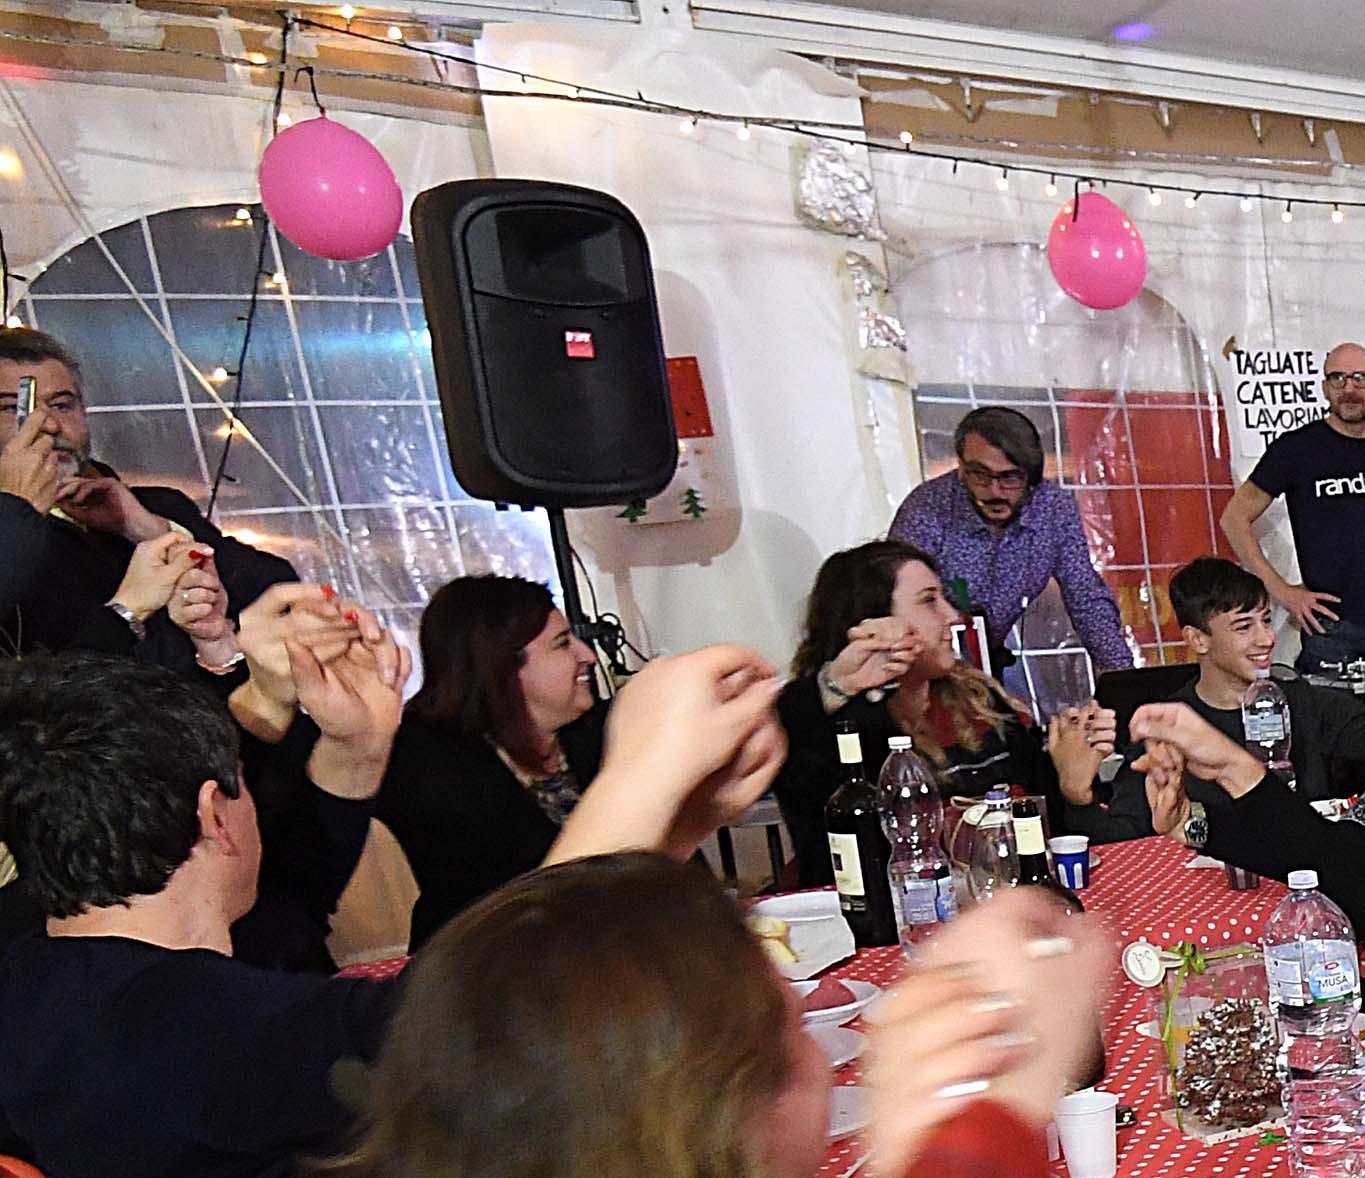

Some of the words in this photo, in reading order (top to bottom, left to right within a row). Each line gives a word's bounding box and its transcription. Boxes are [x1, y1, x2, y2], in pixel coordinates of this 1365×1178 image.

[1234, 350, 1319, 376] TAGLIATE
[1237, 380, 1318, 405] CATENE
[1319, 974, 1348, 989] MUSA
